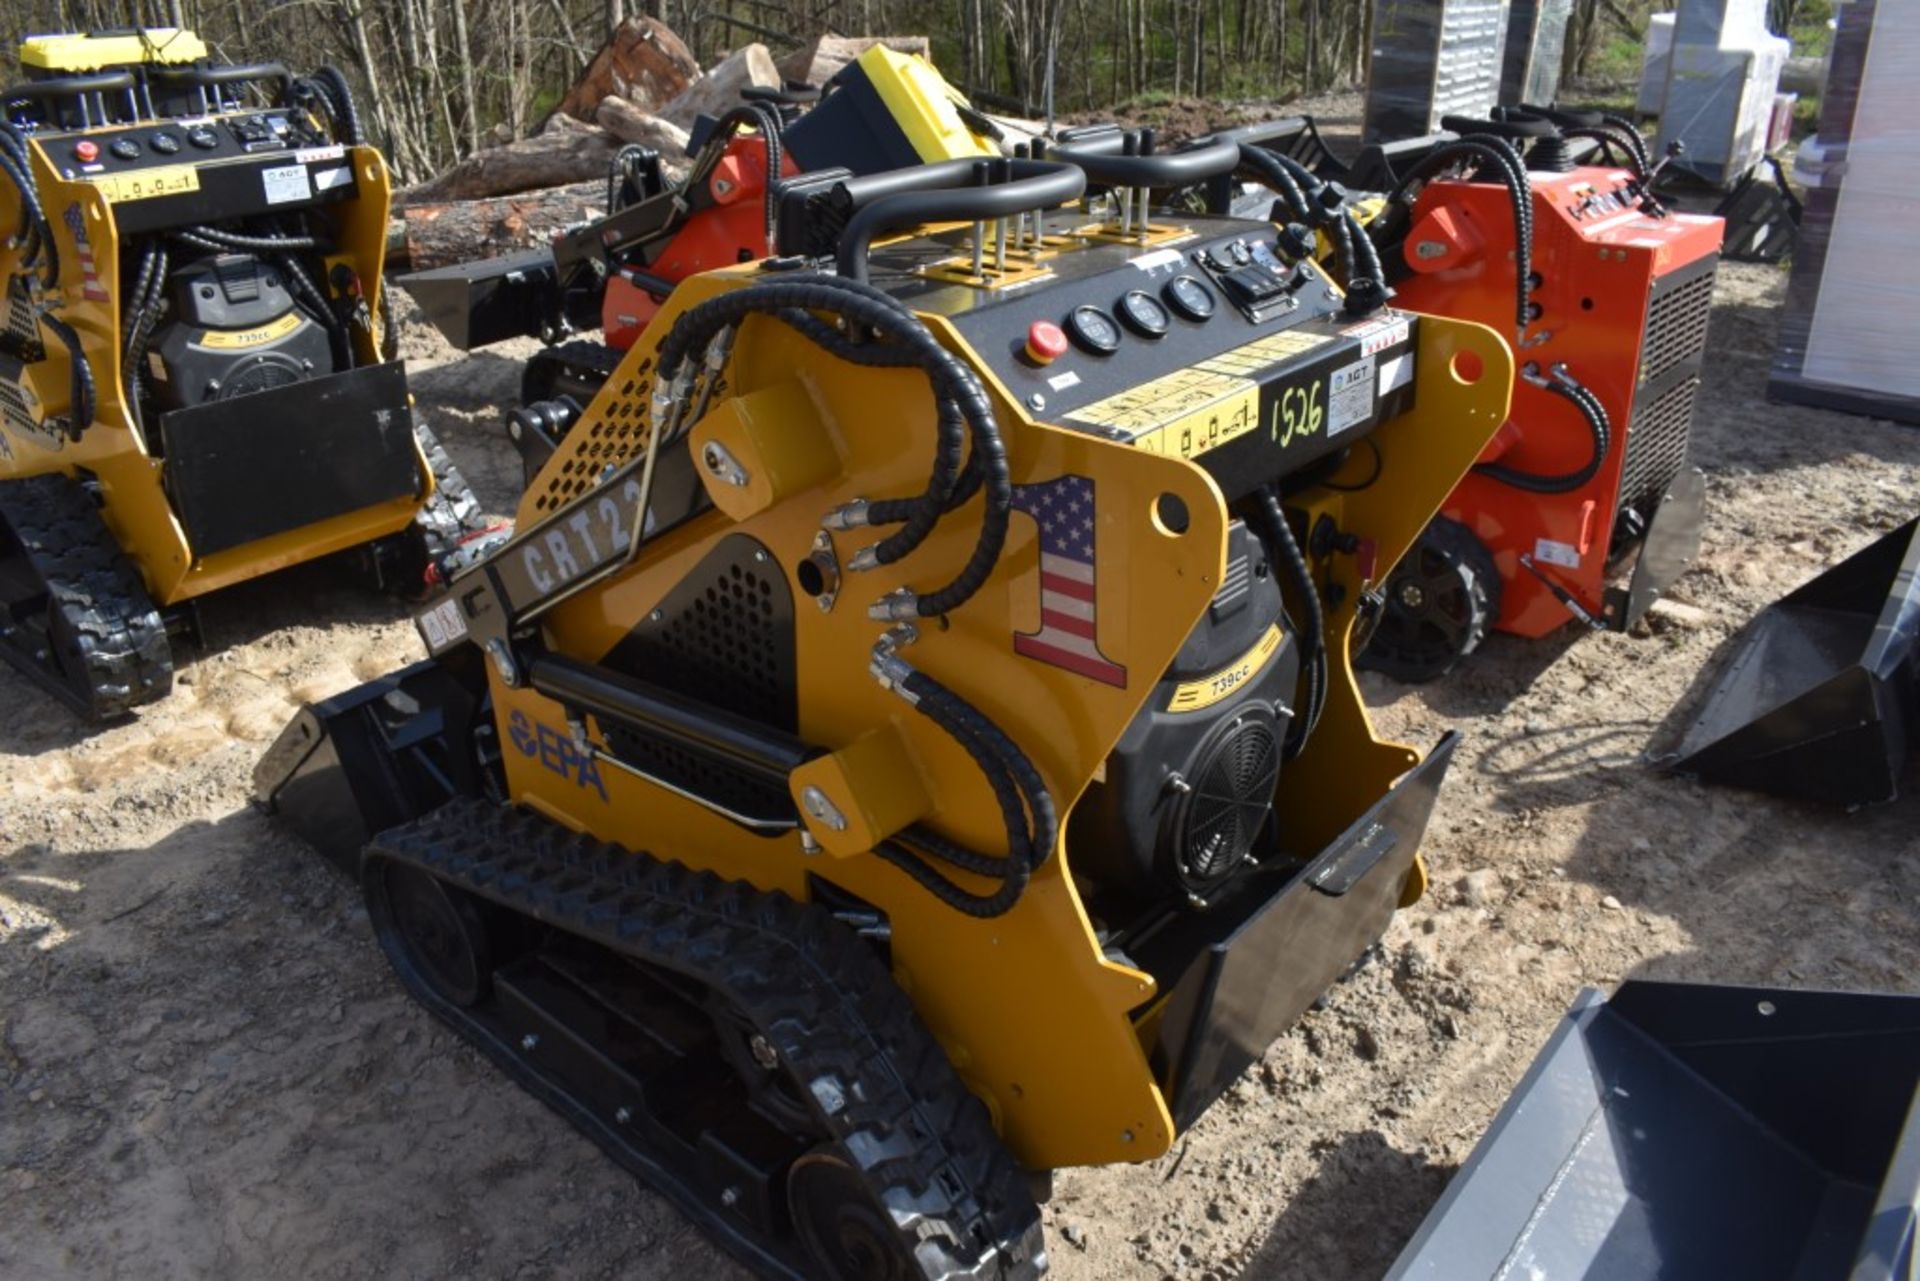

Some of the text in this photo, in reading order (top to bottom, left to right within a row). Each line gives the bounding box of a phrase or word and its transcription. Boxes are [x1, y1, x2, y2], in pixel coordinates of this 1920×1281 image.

[1345, 364, 1369, 385] AGT
[1271, 380, 1323, 448] 1526
[1210, 664, 1250, 697] 739cc
[536, 721, 611, 806] EPA
